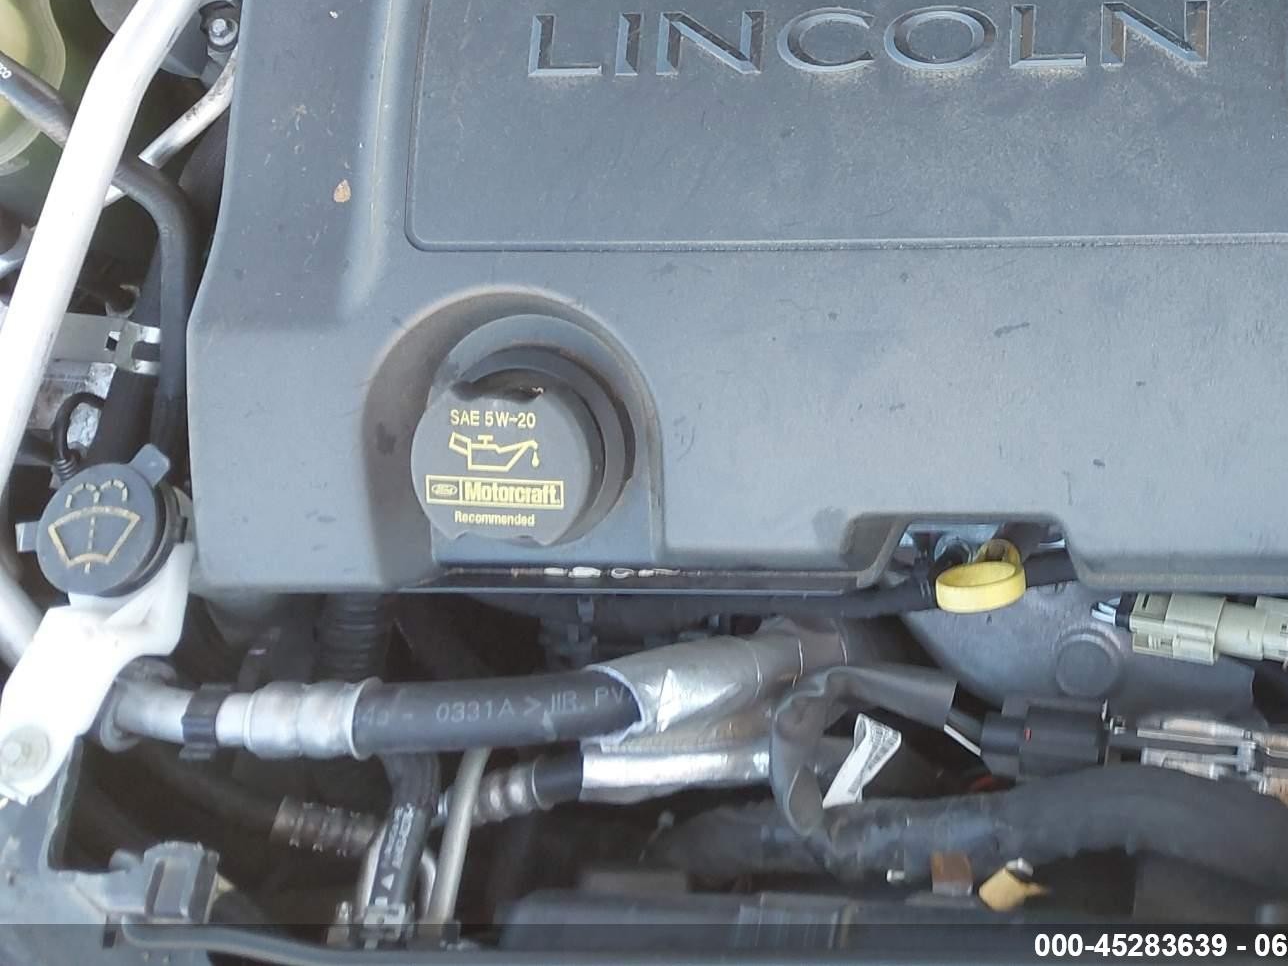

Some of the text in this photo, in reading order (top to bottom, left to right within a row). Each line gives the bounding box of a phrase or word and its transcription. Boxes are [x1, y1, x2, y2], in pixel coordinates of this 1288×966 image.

[450, 409, 536, 429] SAE 5W-20
[454, 510, 536, 527] Recommended
[436, 698, 515, 722] 0331A
